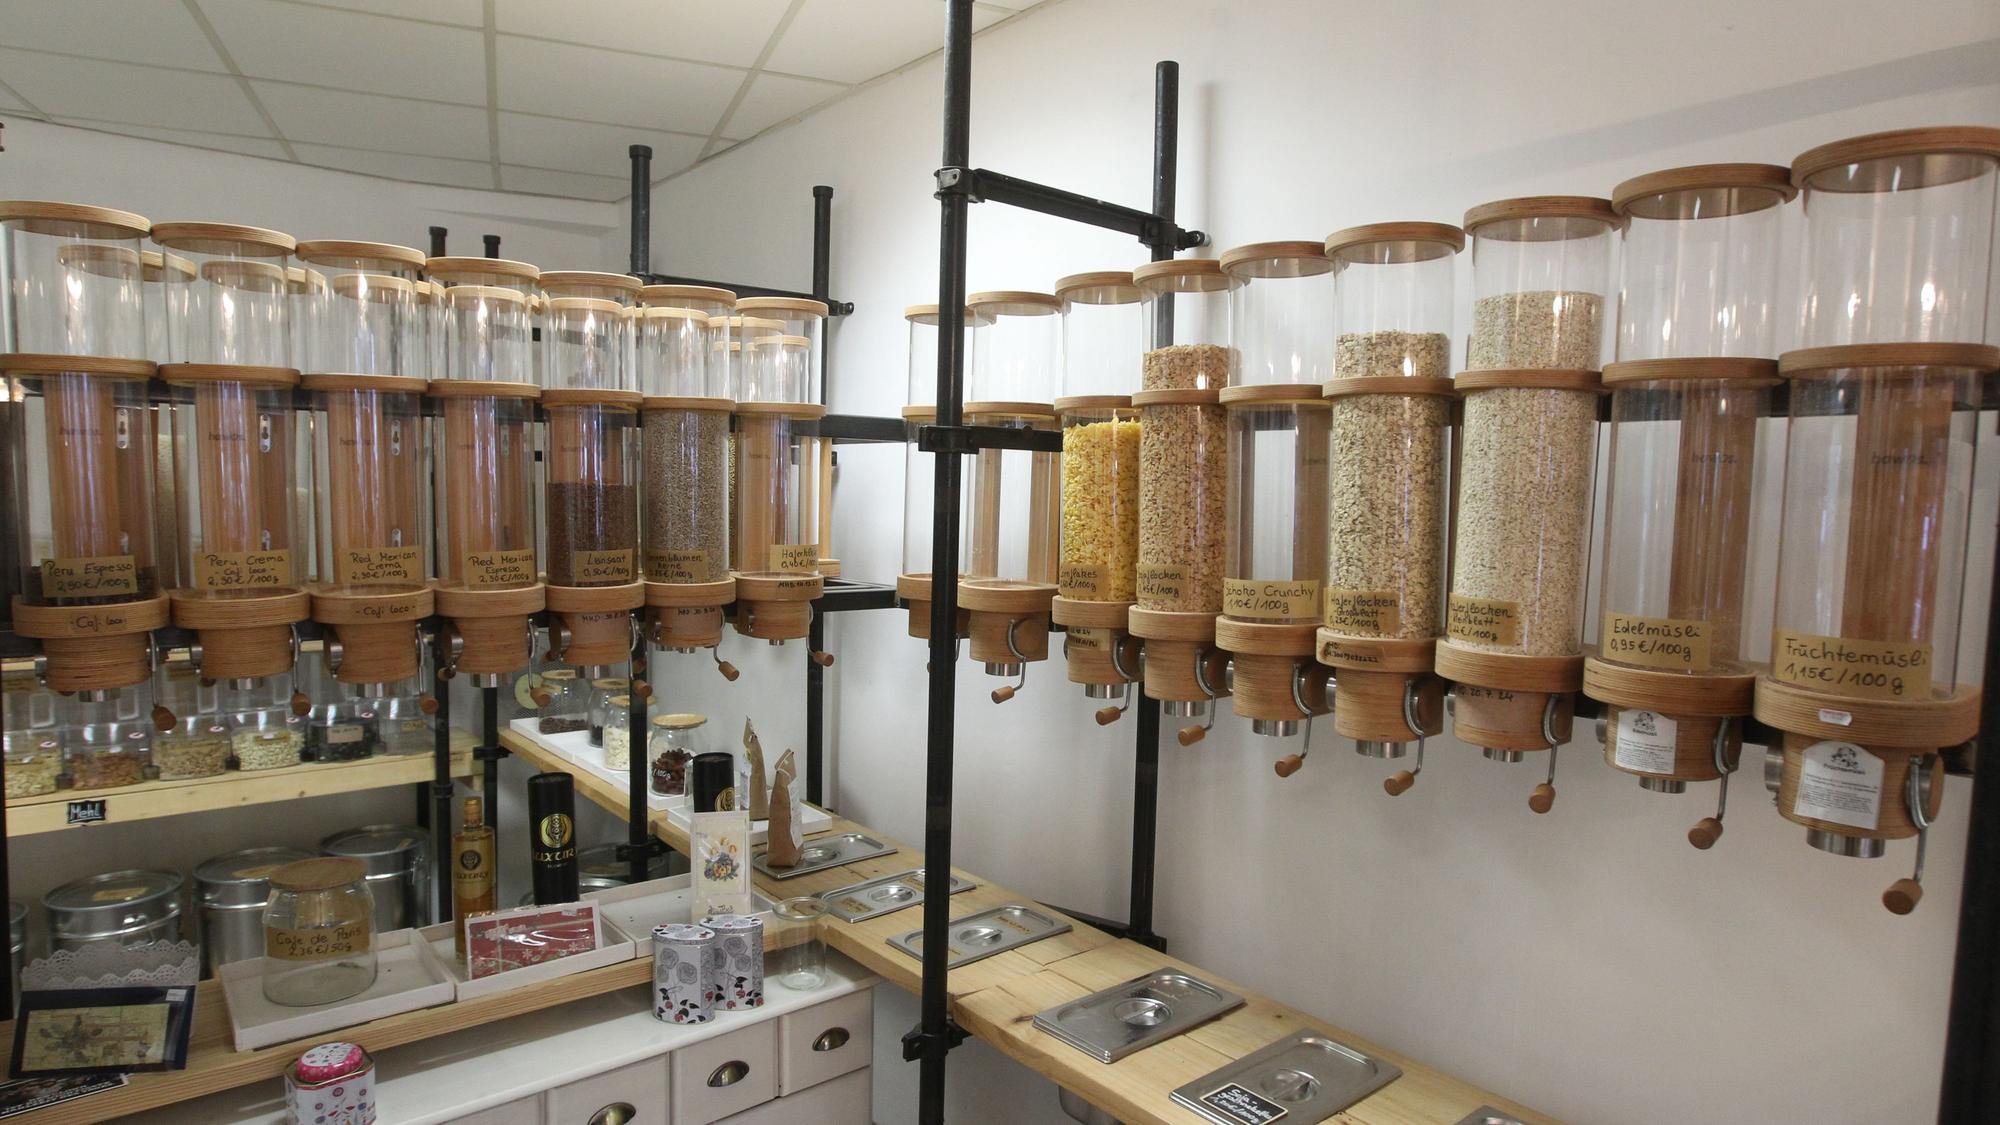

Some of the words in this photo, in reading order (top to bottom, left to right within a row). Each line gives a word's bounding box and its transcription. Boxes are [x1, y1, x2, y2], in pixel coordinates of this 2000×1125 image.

[205, 554, 238, 567] Peru
[246, 555, 285, 566] Crema
[350, 552, 371, 563] Red
[380, 552, 417, 562] Mexican
[468, 555, 495, 566] Red
[43, 560, 74, 577] Peru
[84, 562, 132, 577] Espresso
[367, 562, 402, 571] Crema
[485, 566, 520, 575] Espresso
[1263, 583, 1314, 601] Crunchy
[1614, 619, 1700, 638] Edelmüsli
[1610, 638, 1691, 662] 0,95€/100g
[1786, 638, 1927, 668] Früchtemüsli
[71, 802, 100, 820] Mehl
[311, 934, 327, 945] de
[335, 927, 362, 941] Paris
